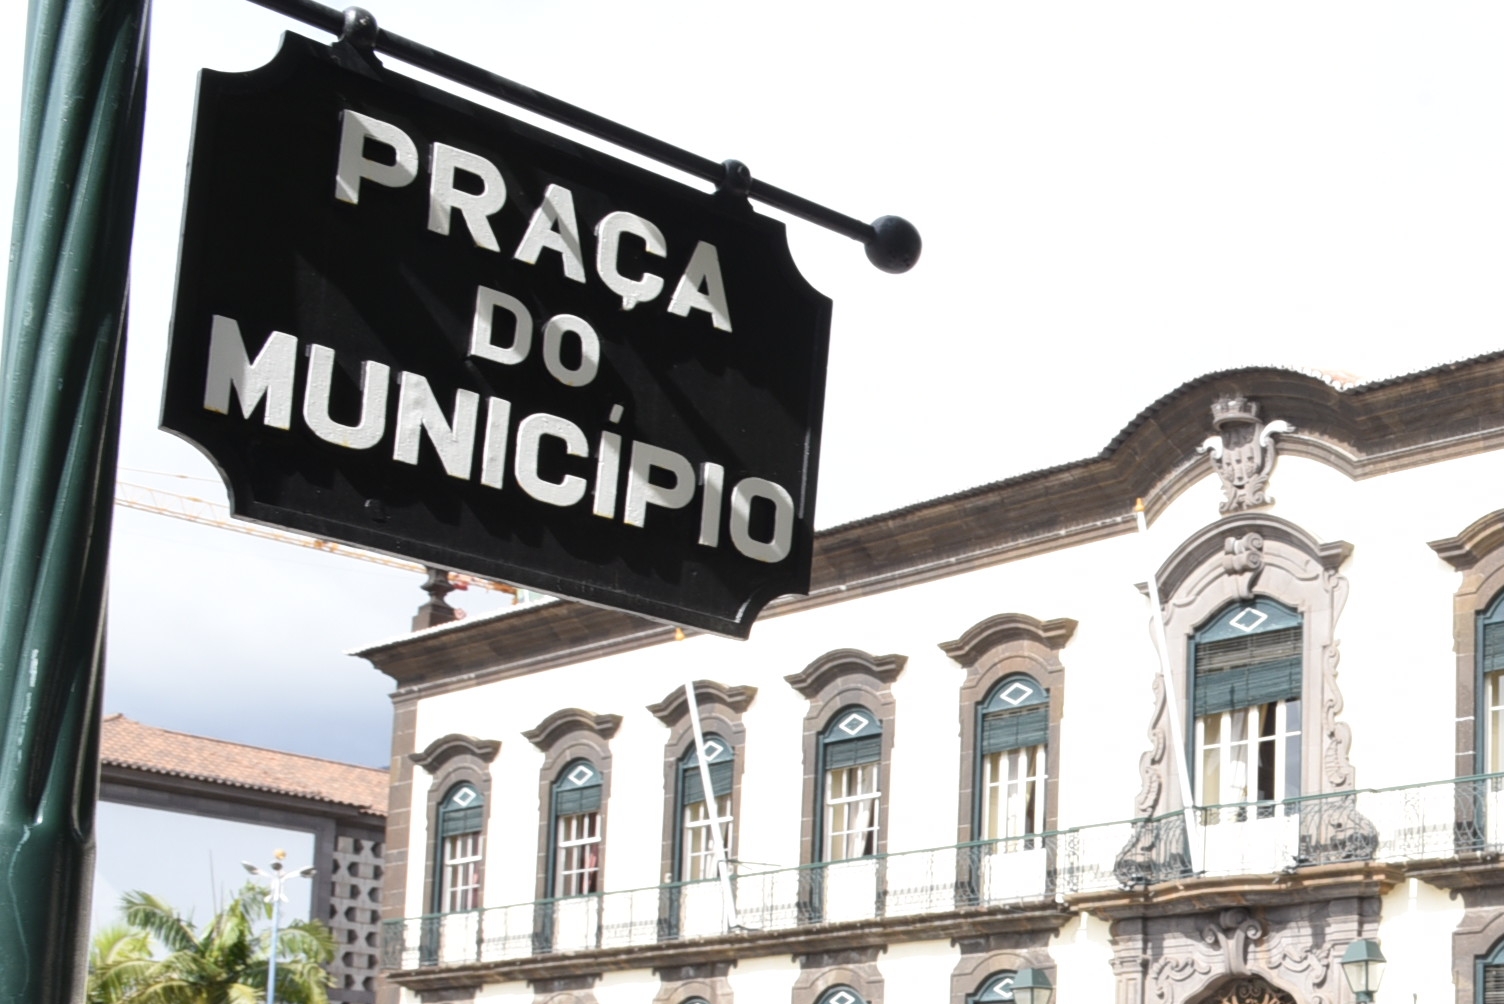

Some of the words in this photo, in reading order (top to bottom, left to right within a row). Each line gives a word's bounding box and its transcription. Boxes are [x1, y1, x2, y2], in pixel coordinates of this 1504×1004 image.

[334, 109, 733, 334] PRAÇA
[204, 314, 795, 564] MUNICÍPIO
[470, 286, 602, 388] DO
